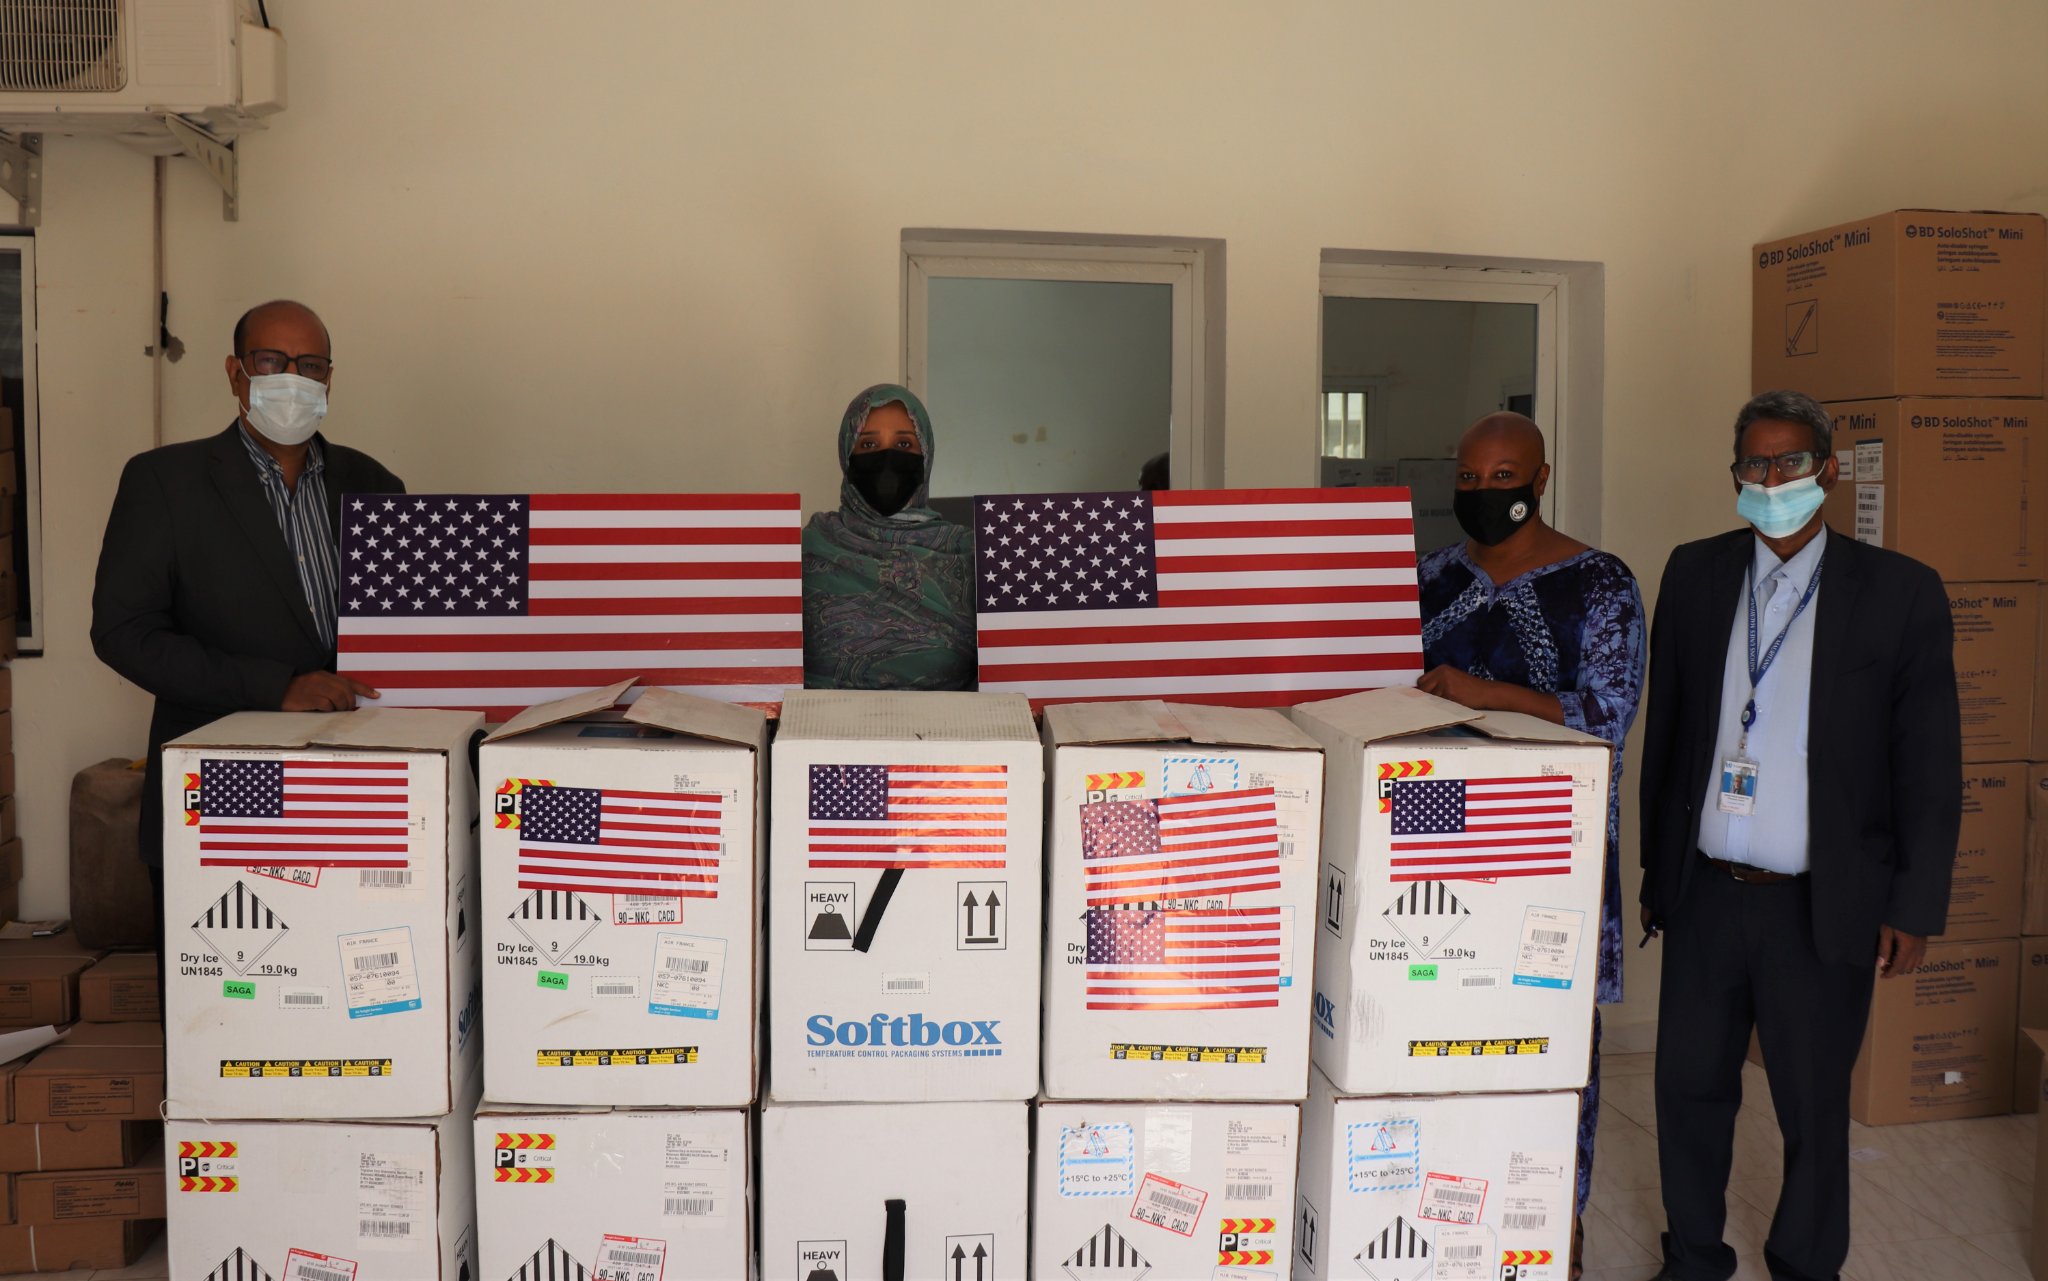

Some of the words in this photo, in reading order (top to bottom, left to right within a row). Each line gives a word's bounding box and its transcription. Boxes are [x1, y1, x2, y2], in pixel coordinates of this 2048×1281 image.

[1919, 226, 1935, 238] BD
[1999, 228, 2023, 240] Mini
[1770, 249, 1784, 266] BD
[1844, 225, 1871, 248] Mini
[1849, 413, 1876, 431] Mini
[1924, 417, 1940, 428] BD
[2003, 417, 2028, 428] Mini
[1992, 596, 2017, 608] Mini
[1981, 777, 2006, 789] Mini
[497, 794, 513, 813] P
[810, 893, 849, 903] HEAVY
[618, 911, 650, 924] 90-NKC
[658, 910, 676, 922] CACD
[1370, 939, 1388, 949] Dry
[1391, 939, 1406, 948] Ice
[1422, 936, 1429, 944] 9
[497, 943, 515, 953] Dry
[518, 944, 534, 953] Ice
[551, 942, 558, 950] 9
[1067, 943, 1086, 954] Dry
[180, 953, 200, 964] Dry
[203, 953, 219, 963] Ice
[237, 951, 244, 960] 9
[497, 956, 538, 966] UN1845
[1369, 952, 1409, 961] UN1845
[1975, 956, 1999, 969] Mini
[181, 966, 223, 976] UN1845
[541, 976, 565, 985] SAGA
[226, 985, 252, 995] SAGA
[806, 1013, 1002, 1046] Softbox
[932, 1049, 963, 1057] SYSTEMS
[497, 1149, 513, 1167] P
[181, 1157, 197, 1176] P
[1092, 1174, 1101, 1182] to
[1136, 1207, 1166, 1226] 90-NKC
[1171, 1218, 1189, 1233] CACD
[1423, 1206, 1452, 1221] 90-NKC
[1458, 1211, 1474, 1223] CACD
[1220, 1233, 1237, 1251] P
[803, 1251, 841, 1260] HEAVY
